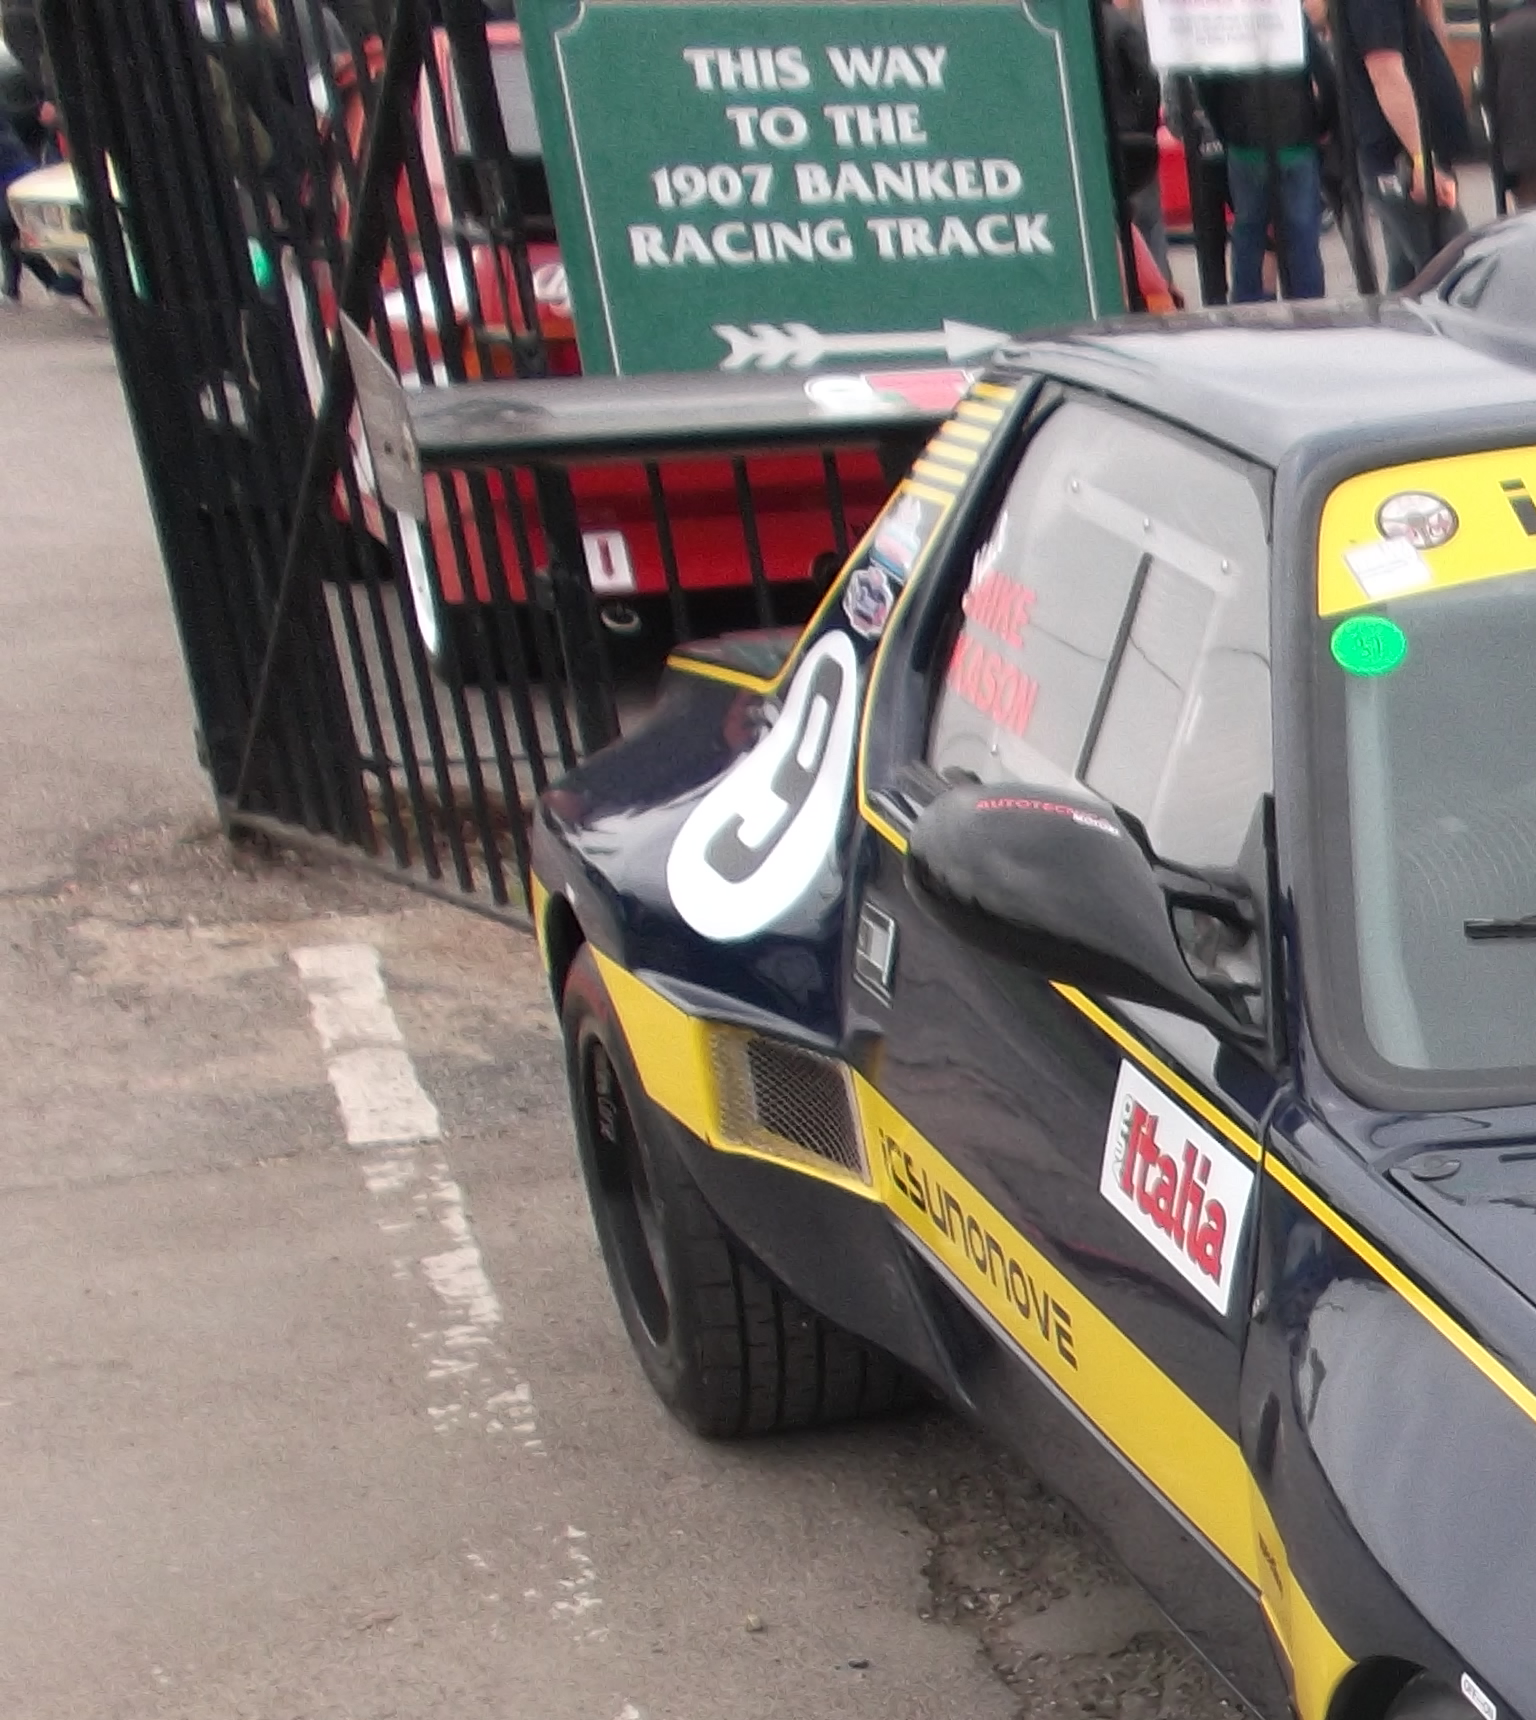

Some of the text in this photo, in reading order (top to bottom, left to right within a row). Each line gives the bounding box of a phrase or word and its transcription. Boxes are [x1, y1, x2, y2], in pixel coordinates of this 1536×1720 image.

[683, 44, 947, 92] THIS WAY
[726, 103, 927, 149] TO THE
[651, 159, 1023, 209] 1907 BANKED
[627, 213, 1054, 268] RACING TRACK
[704, 653, 843, 884] 9
[1119, 1100, 1227, 1288] Italia
